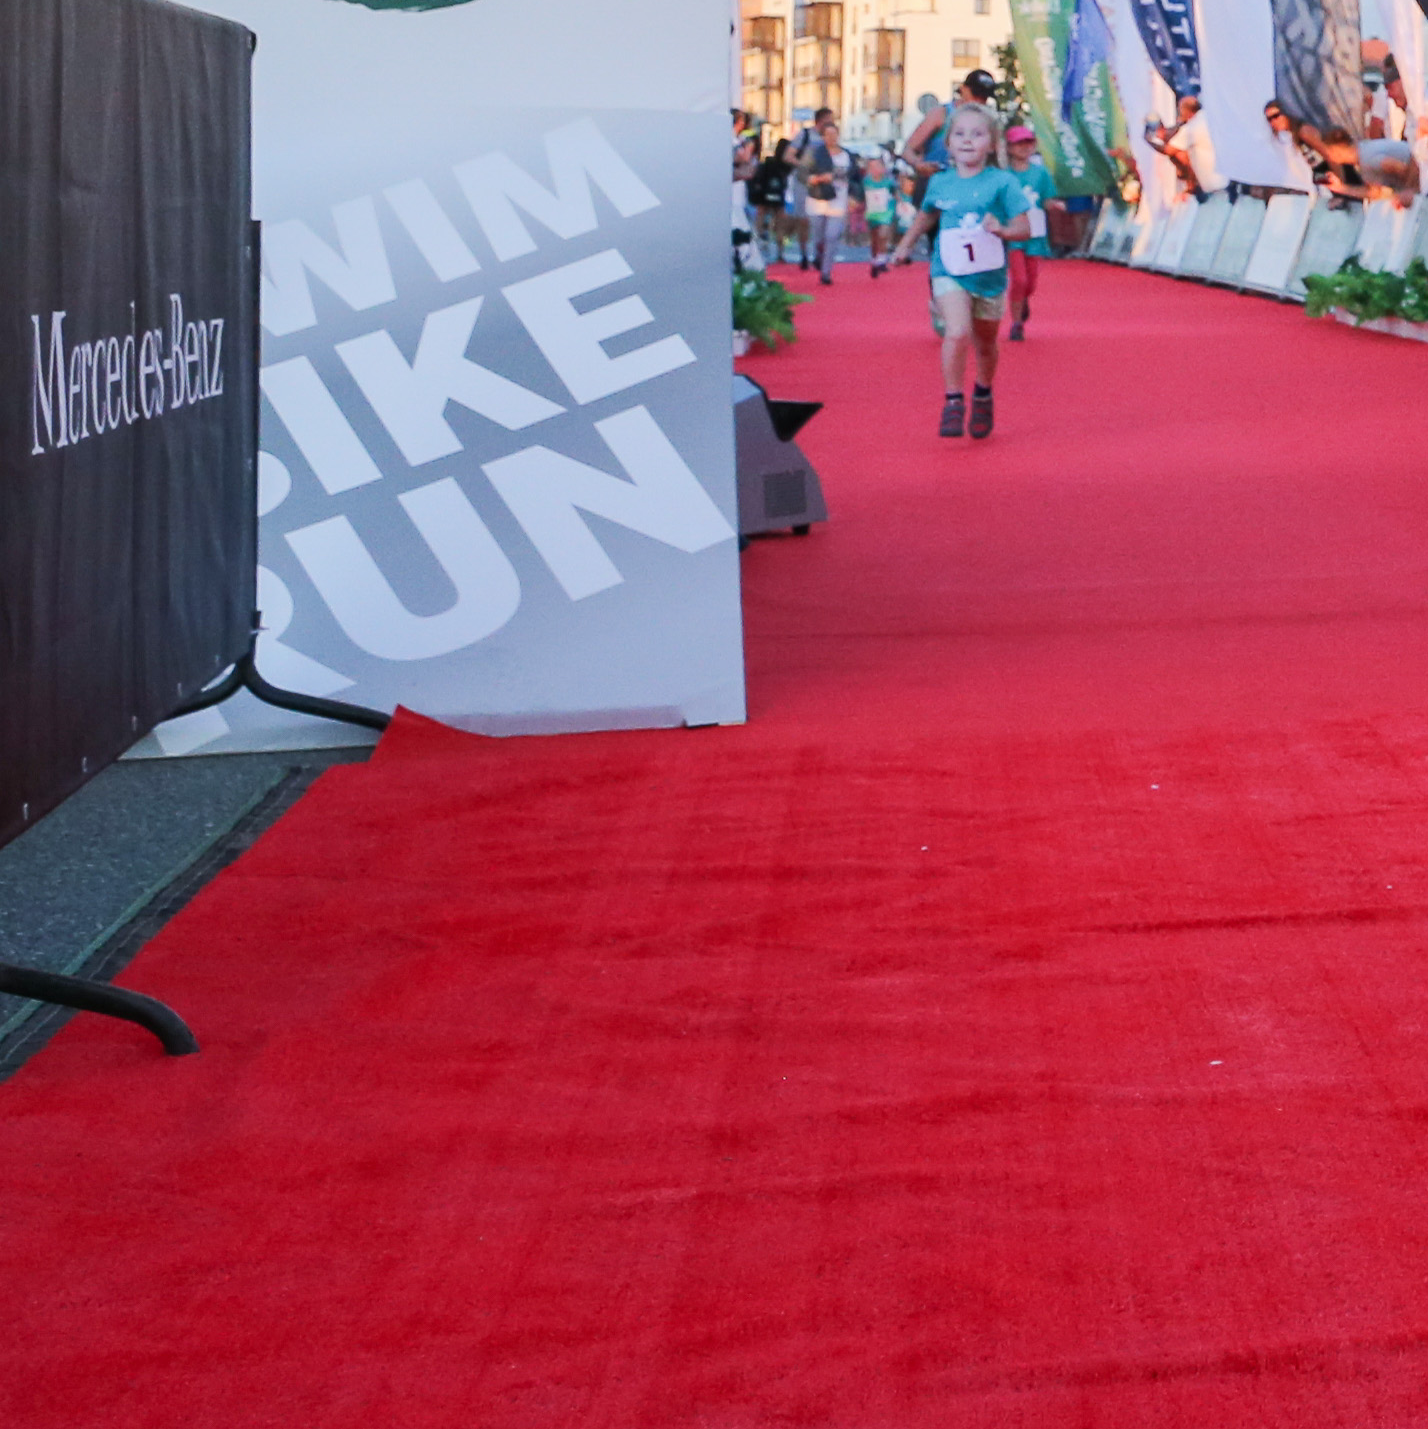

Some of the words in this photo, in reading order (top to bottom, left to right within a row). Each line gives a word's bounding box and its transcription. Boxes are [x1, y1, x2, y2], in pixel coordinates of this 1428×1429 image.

[260, 116, 661, 337] WIM
[963, 243, 975, 262] 1
[31, 293, 224, 455] Mercedes-Benz
[258, 249, 697, 517] IKE
